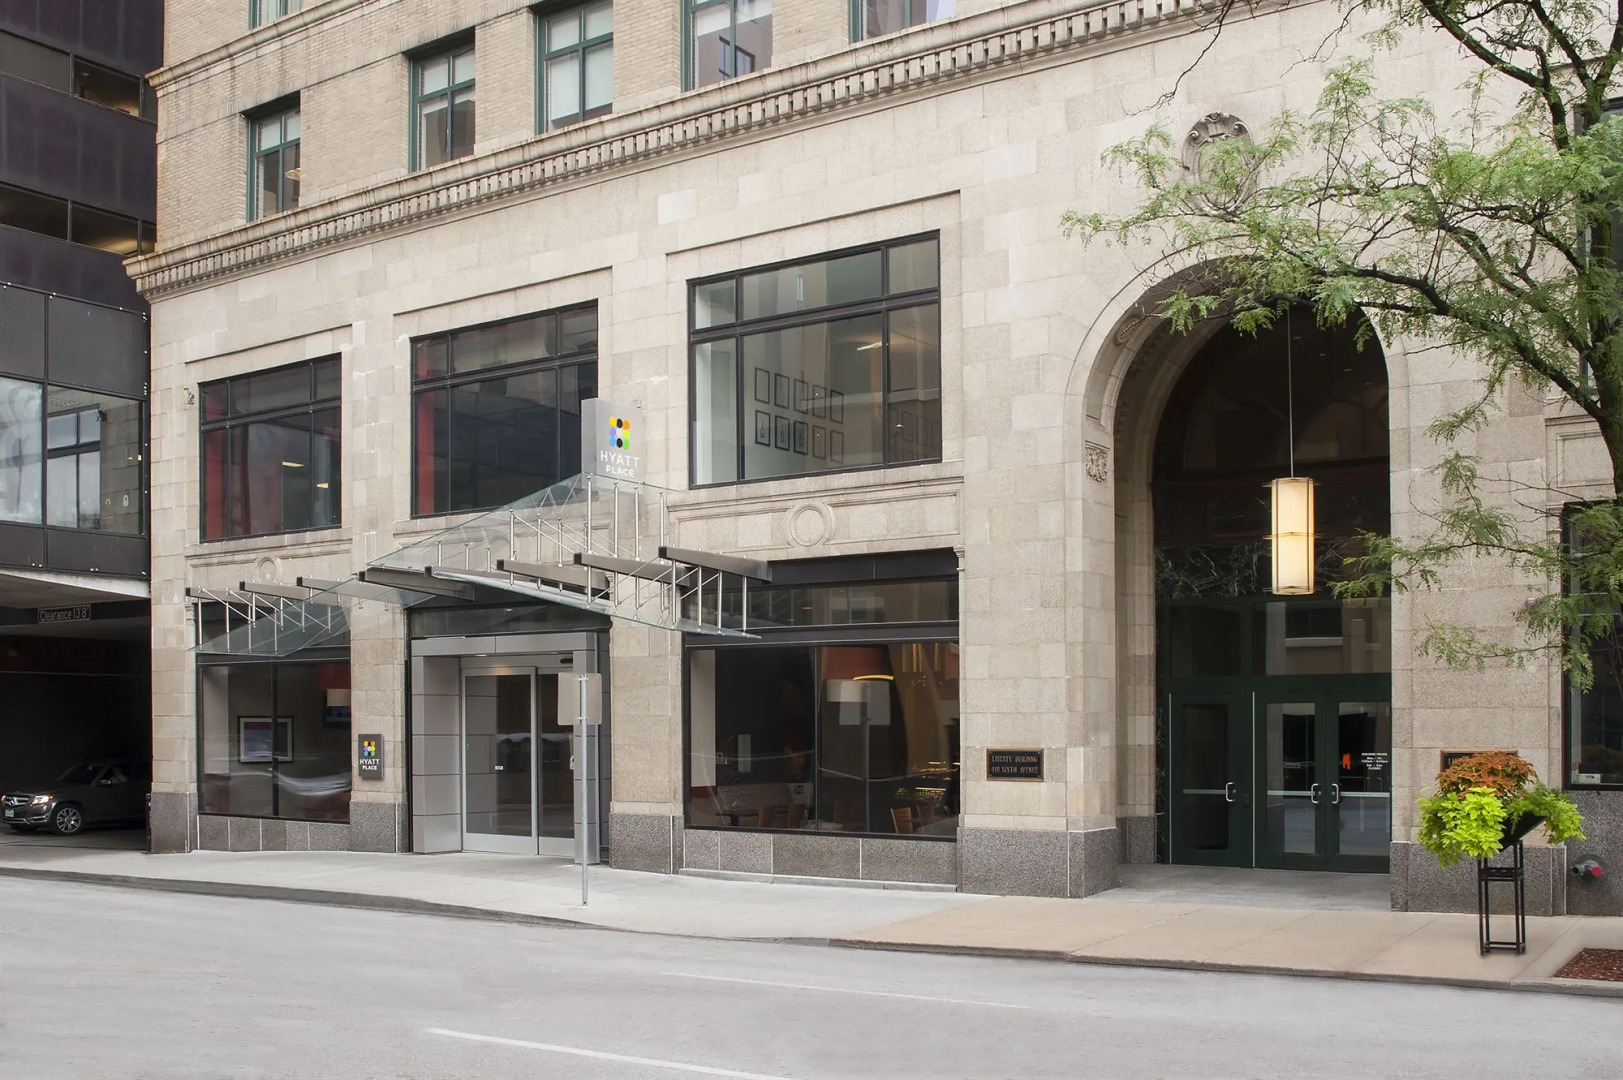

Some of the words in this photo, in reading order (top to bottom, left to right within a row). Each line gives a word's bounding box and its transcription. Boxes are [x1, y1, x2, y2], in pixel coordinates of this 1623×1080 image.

[600, 450, 640, 468] HYATT
[606, 464, 635, 478] PLACE
[40, 610, 72, 621] Clearance
[991, 755, 1013, 763] LIBERTY
[1020, 766, 1039, 774] AVENUE
